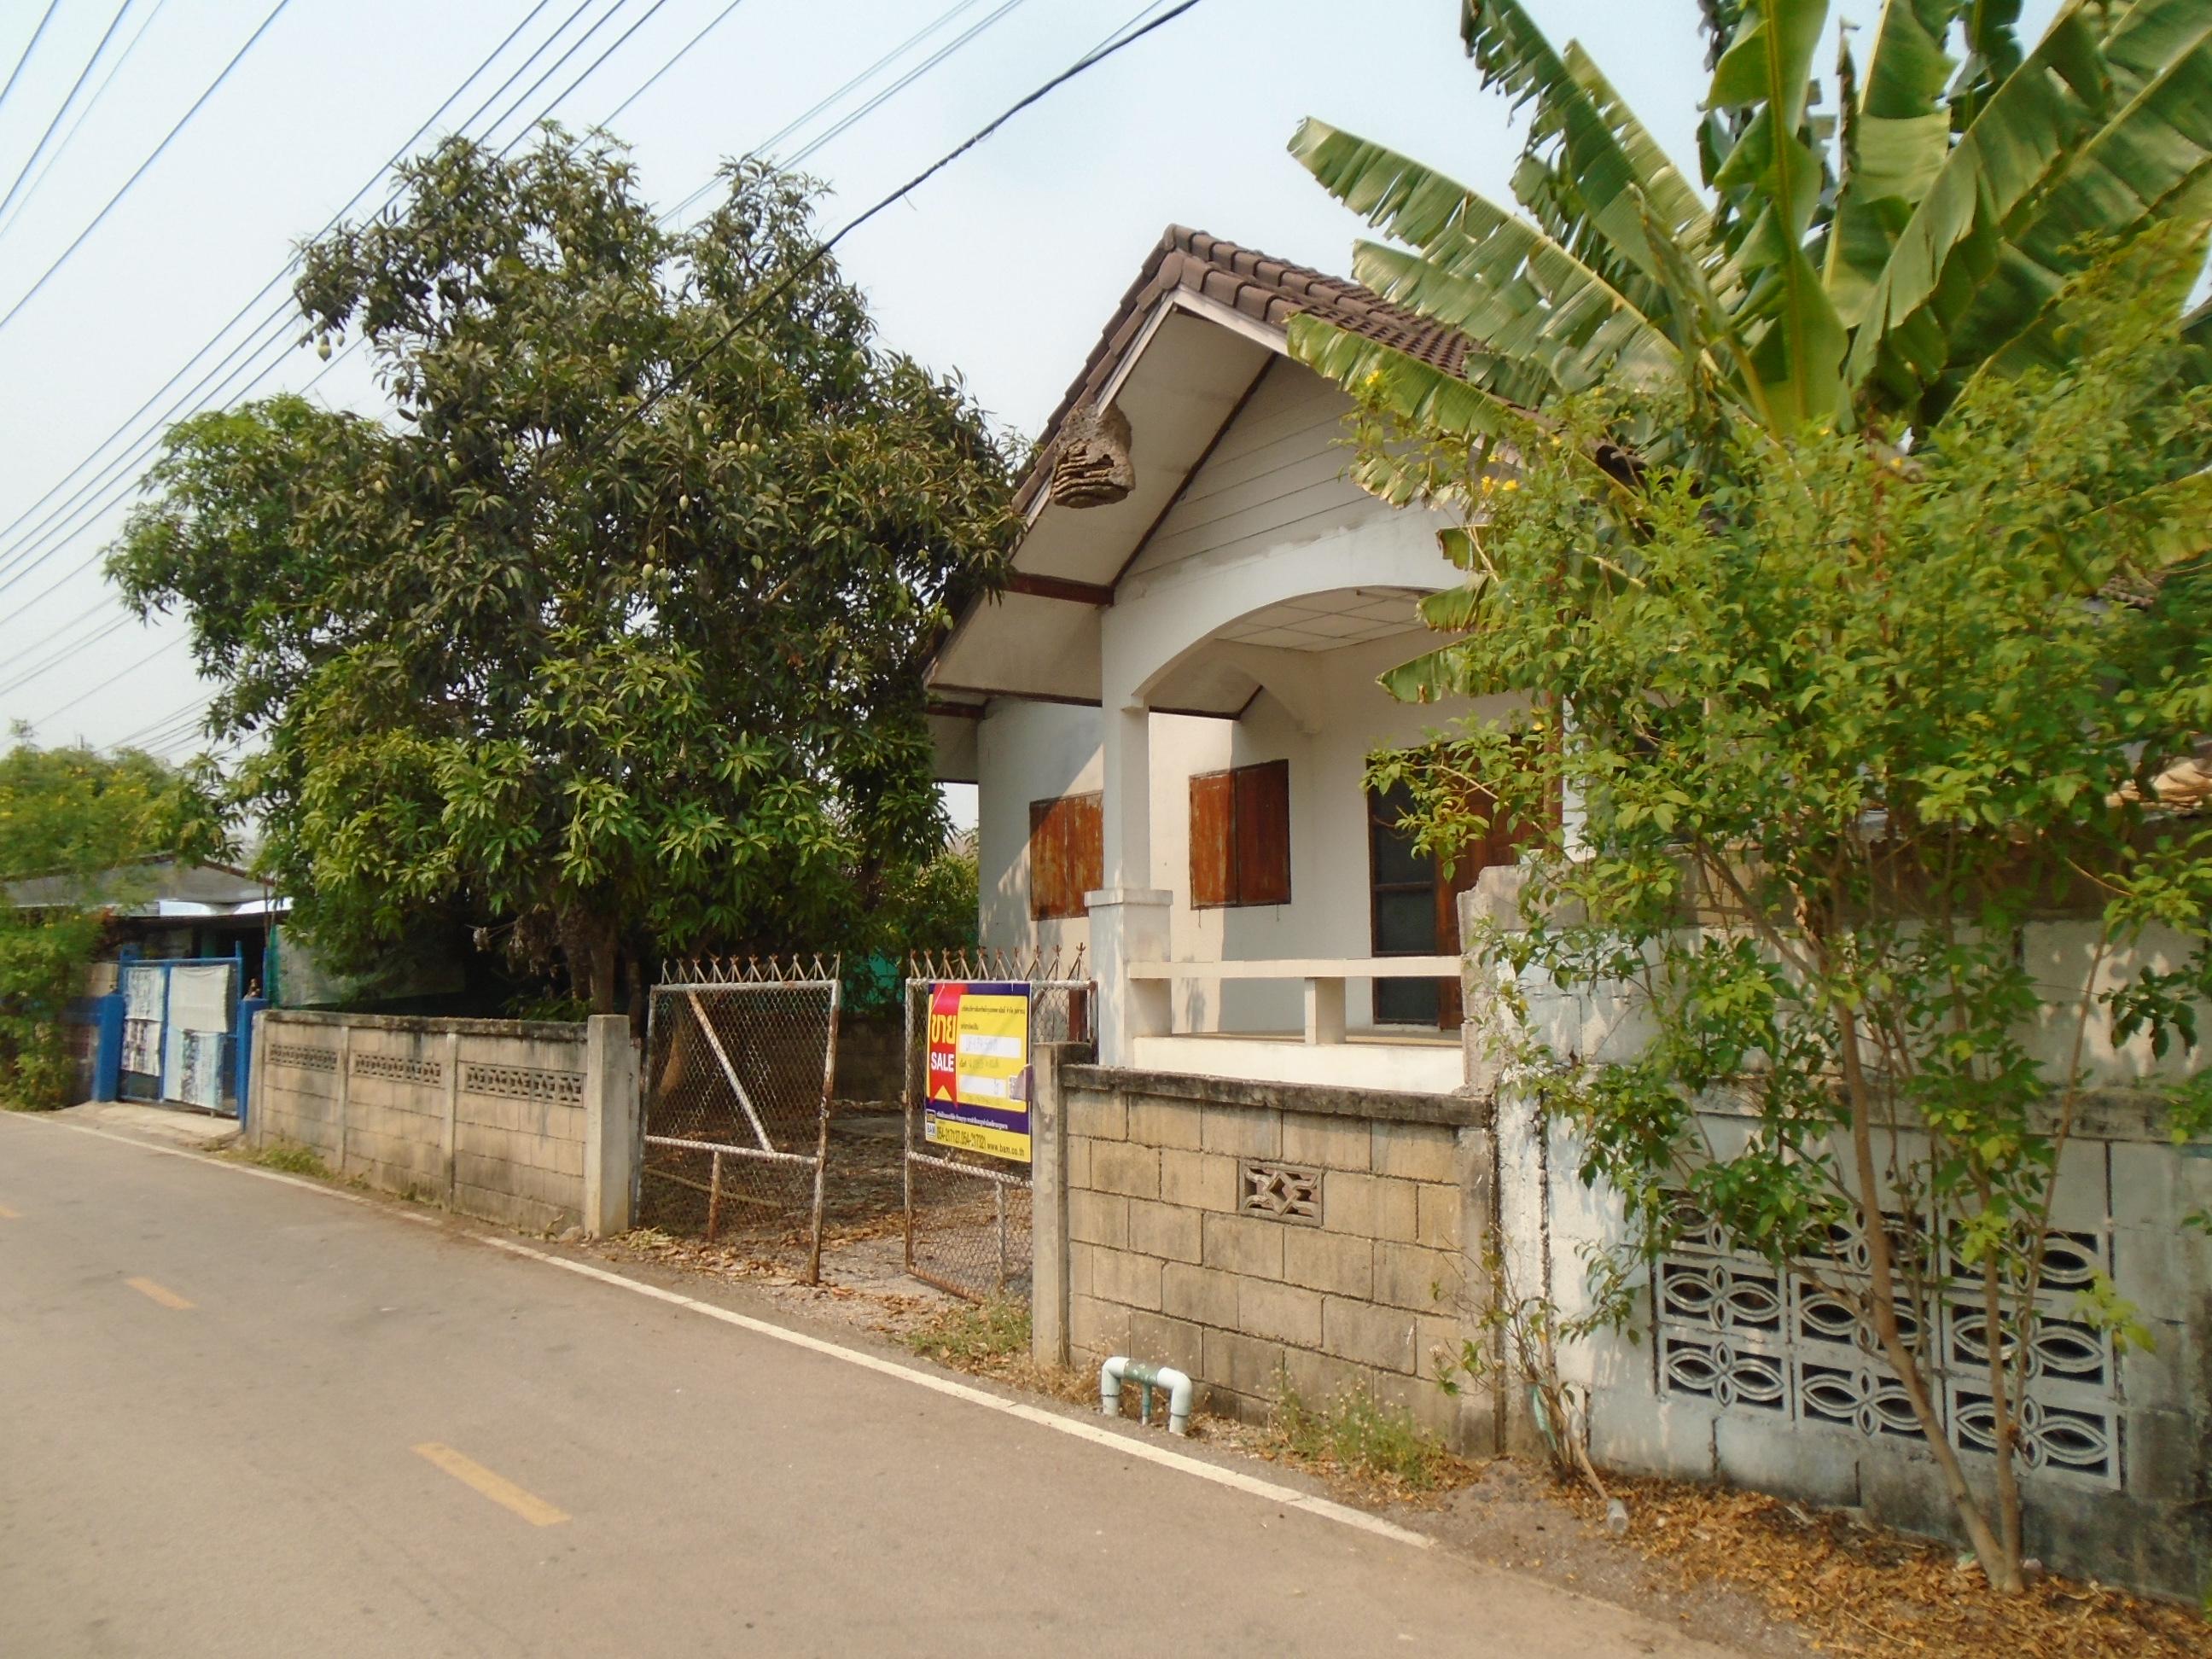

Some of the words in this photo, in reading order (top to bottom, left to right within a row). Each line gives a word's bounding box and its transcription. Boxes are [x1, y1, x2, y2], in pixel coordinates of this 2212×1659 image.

[931, 1051, 955, 1072] SALE
[927, 1124, 935, 1134] BAM
[987, 1143, 1025, 1156] www.bam.co.th
